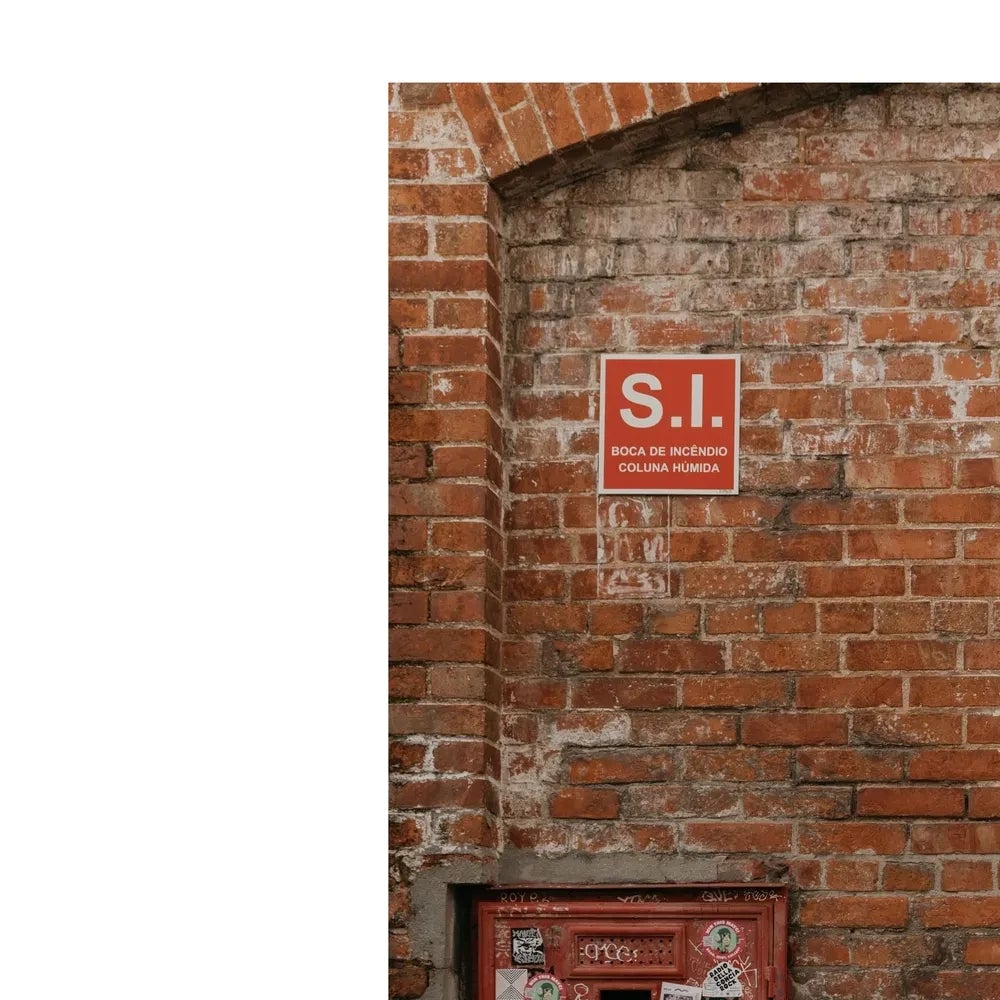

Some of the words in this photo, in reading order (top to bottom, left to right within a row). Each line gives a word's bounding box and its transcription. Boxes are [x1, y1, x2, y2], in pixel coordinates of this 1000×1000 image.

[620, 373, 723, 428] S.I.
[611, 446, 646, 457] BOCA
[650, 446, 666, 457] DE
[670, 444, 728, 457] INCÊNDIO
[619, 462, 669, 473] COLUNA
[673, 460, 720, 473] HÚMIDA
[709, 962, 728, 978] RADIO
[713, 968, 732, 981] DELLA
[716, 969, 740, 987] CONCIA
[719, 979, 737, 991] ROCK
